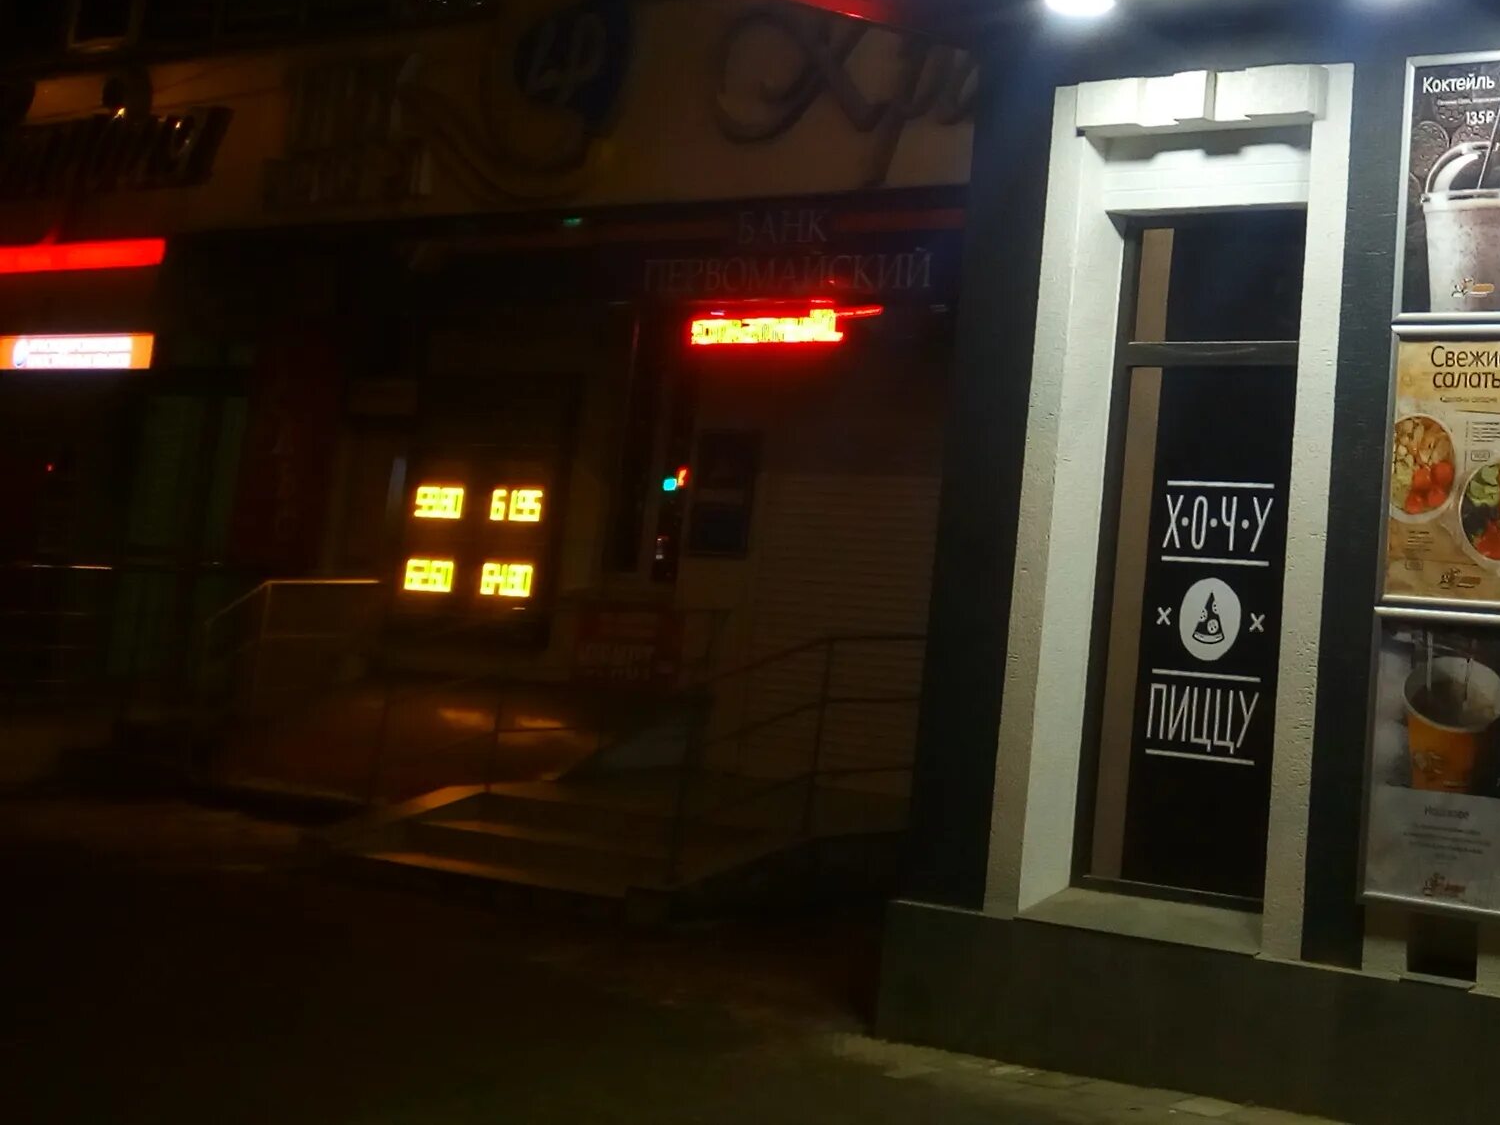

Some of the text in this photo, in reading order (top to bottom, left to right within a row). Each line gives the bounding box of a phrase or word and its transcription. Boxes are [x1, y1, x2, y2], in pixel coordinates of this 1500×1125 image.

[1422, 73, 1495, 95] Коктейль
[737, 208, 830, 245] БАНК
[642, 246, 935, 293] ПЕРВОМАЙСКИЙ
[1146, 682, 1260, 755] ПИЦЦУ
